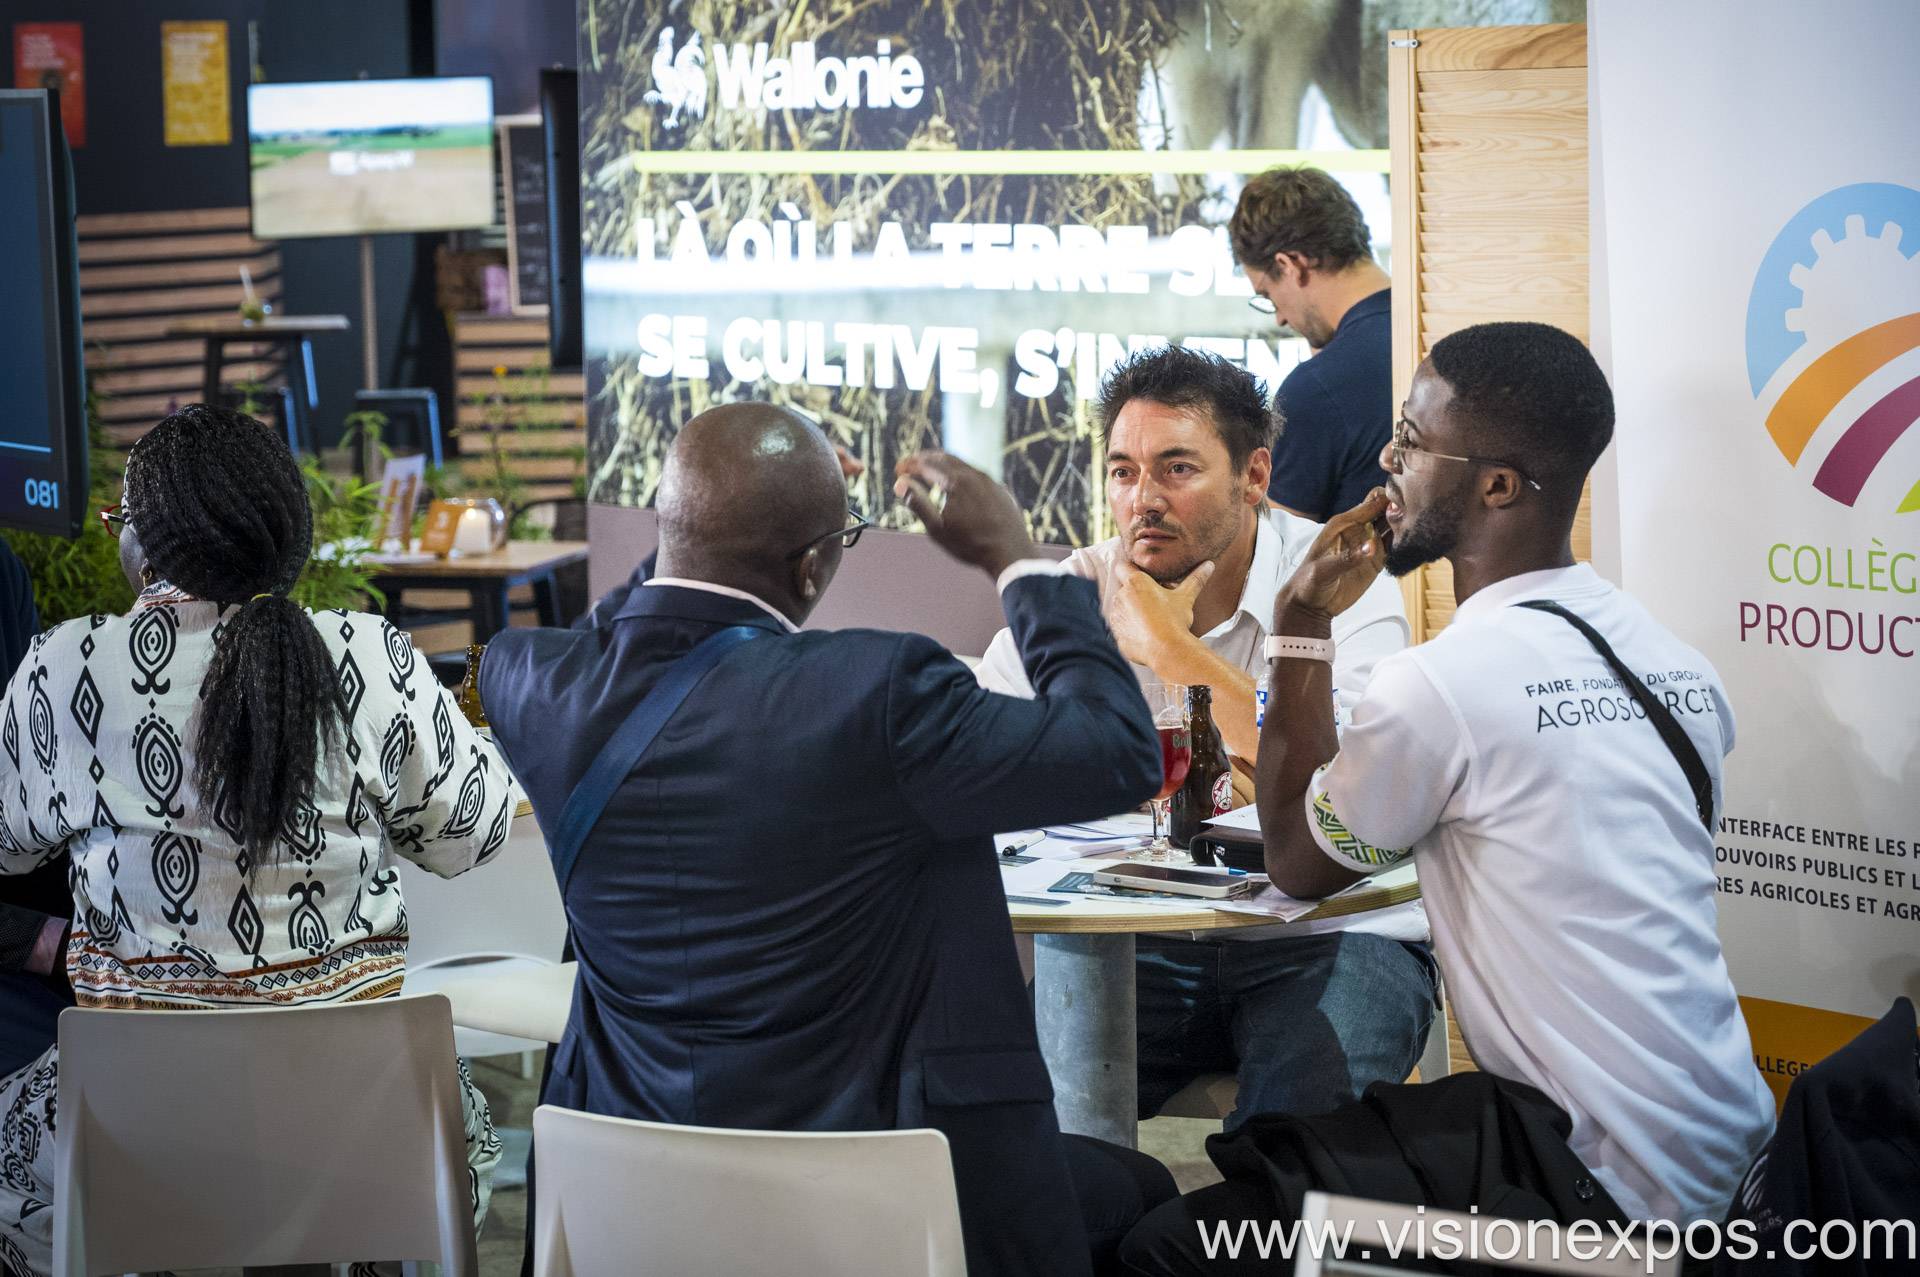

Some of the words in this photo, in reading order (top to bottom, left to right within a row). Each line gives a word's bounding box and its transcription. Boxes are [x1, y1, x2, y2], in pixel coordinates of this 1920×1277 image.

[712, 38, 925, 110] Wallonie
[833, 220, 916, 286] LA
[930, 222, 1150, 294] TERRE
[637, 313, 710, 379] SE
[722, 317, 999, 409] CULTIVE,
[24, 478, 59, 509] 081
[1767, 537, 1917, 594] COLLÈG
[1525, 678, 1580, 698] FAIRE,
[1583, 677, 1629, 691] FONDAT
[1646, 672, 1667, 686] DU
[1668, 670, 1702, 682] GROU
[1536, 687, 1714, 734] AGROSORCE
[1812, 828, 1869, 852] ENTRE
[1875, 837, 1907, 858] LES
[1715, 846, 1797, 872] OUVOIRS
[1802, 857, 1878, 884] PUBLICS
[1884, 869, 1906, 888] ET
[1750, 880, 1851, 911] AGRICOLES
[1856, 896, 1878, 915] ET
